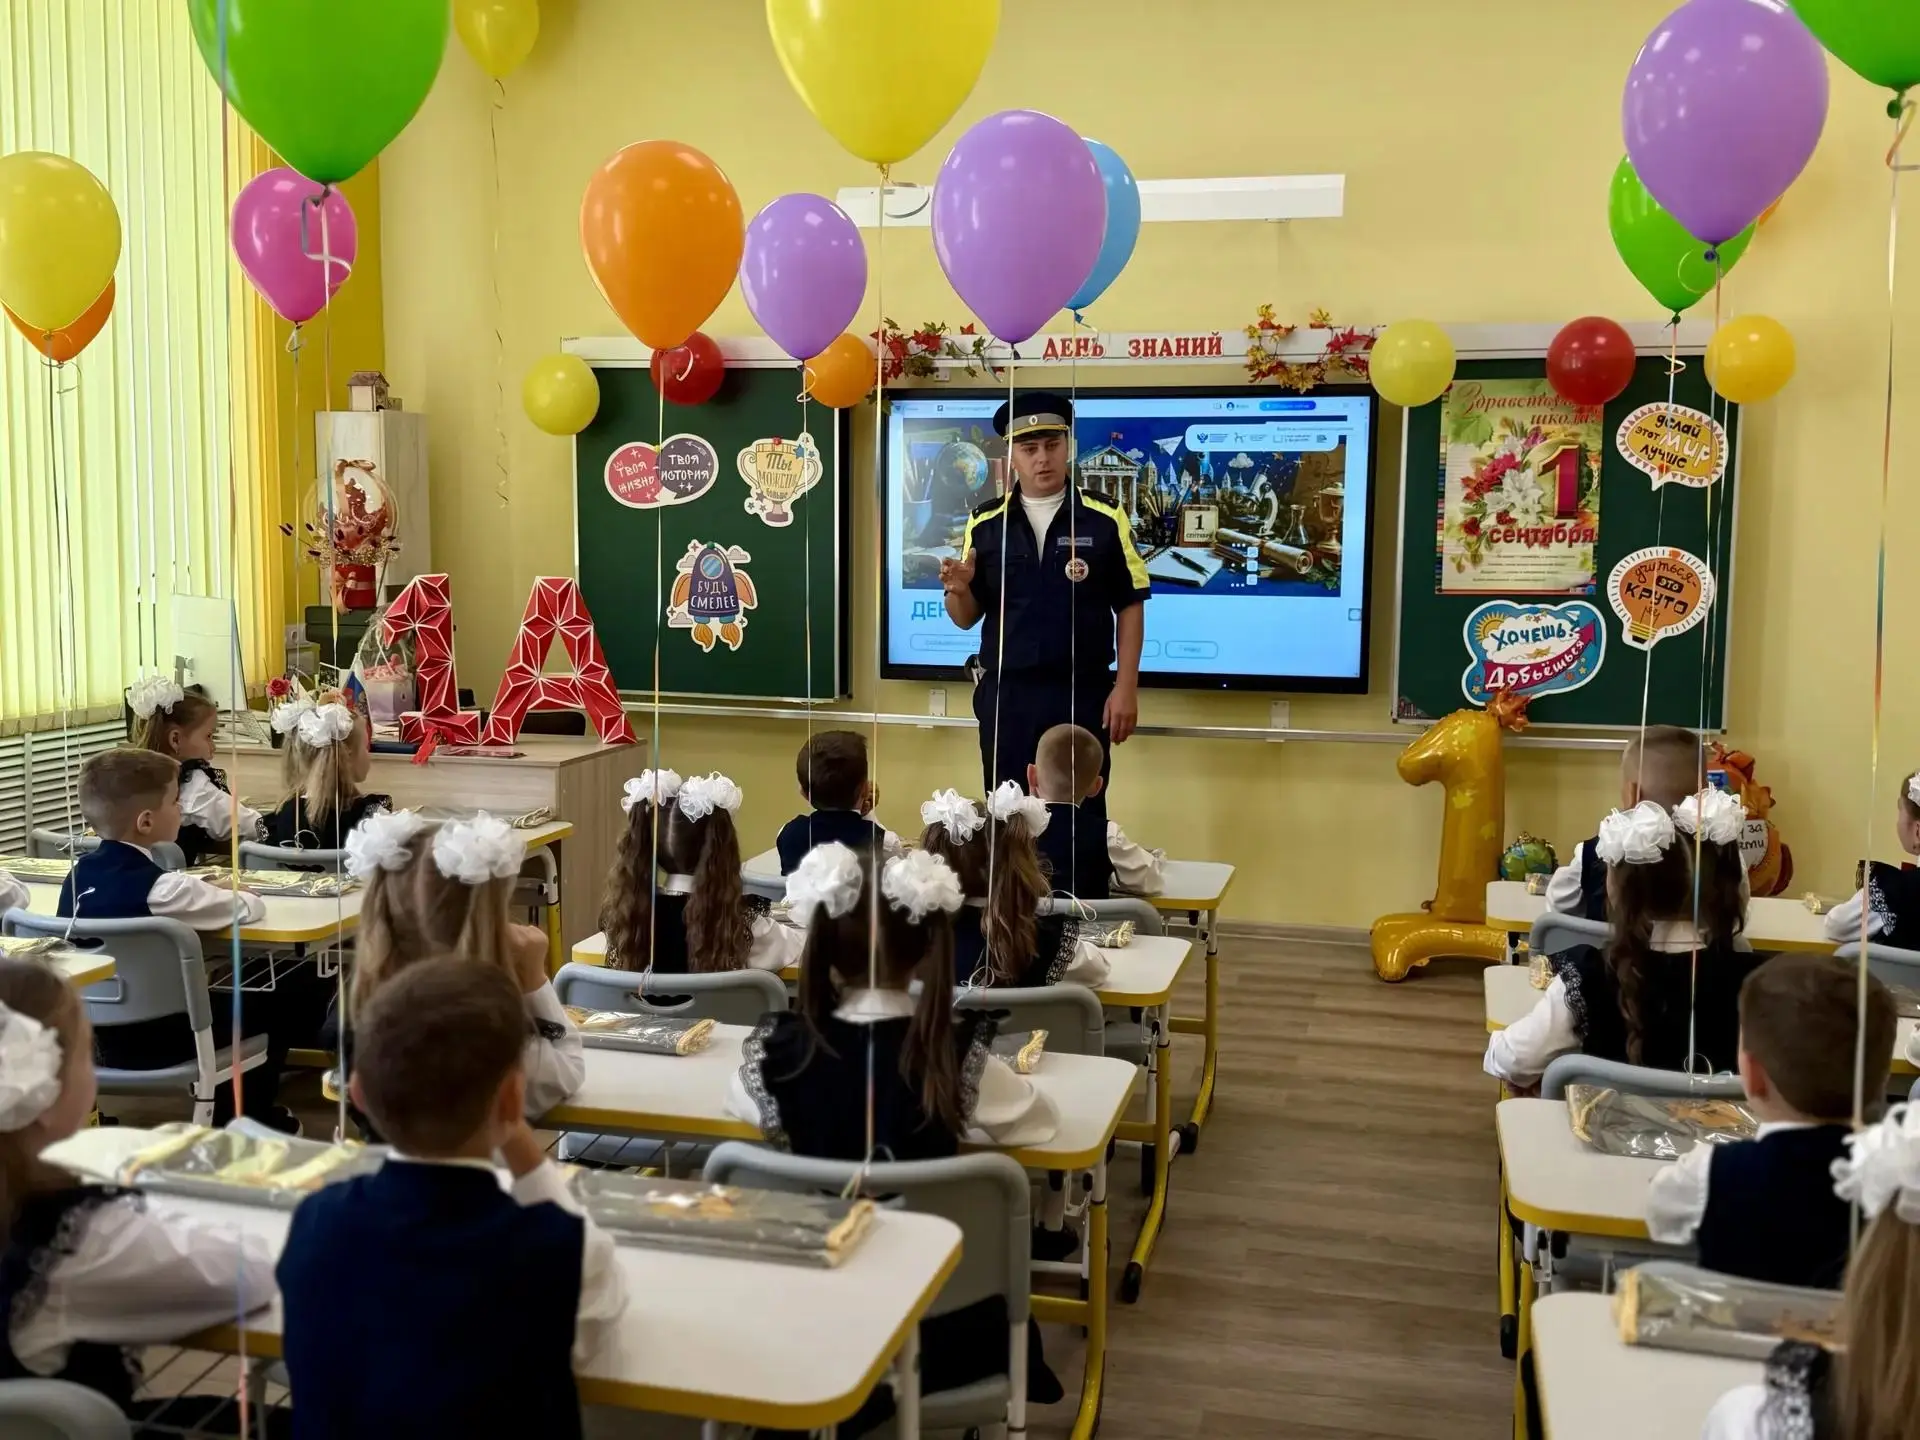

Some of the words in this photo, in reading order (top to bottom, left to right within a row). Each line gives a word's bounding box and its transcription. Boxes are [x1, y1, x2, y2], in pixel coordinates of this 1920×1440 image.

[1043, 337, 1105, 360] ДЕНЬ
[1128, 331, 1222, 357] ЗНАНИЙ
[668, 454, 699, 465] ТВОЯ
[615, 462, 647, 478] ТВОЯ
[661, 470, 709, 481] ИСТОРИЯ
[618, 476, 655, 494] ЖИЗНЬ
[1537, 443, 1579, 519] 1
[1195, 514, 1204, 530] 1
[1489, 522, 1595, 548] сентября
[697, 580, 728, 595] БУДЬ
[691, 595, 737, 610] СМЕЛЕЕ
[1625, 582, 1689, 615] КРУТО
[911, 600, 945, 620] ДЕН
